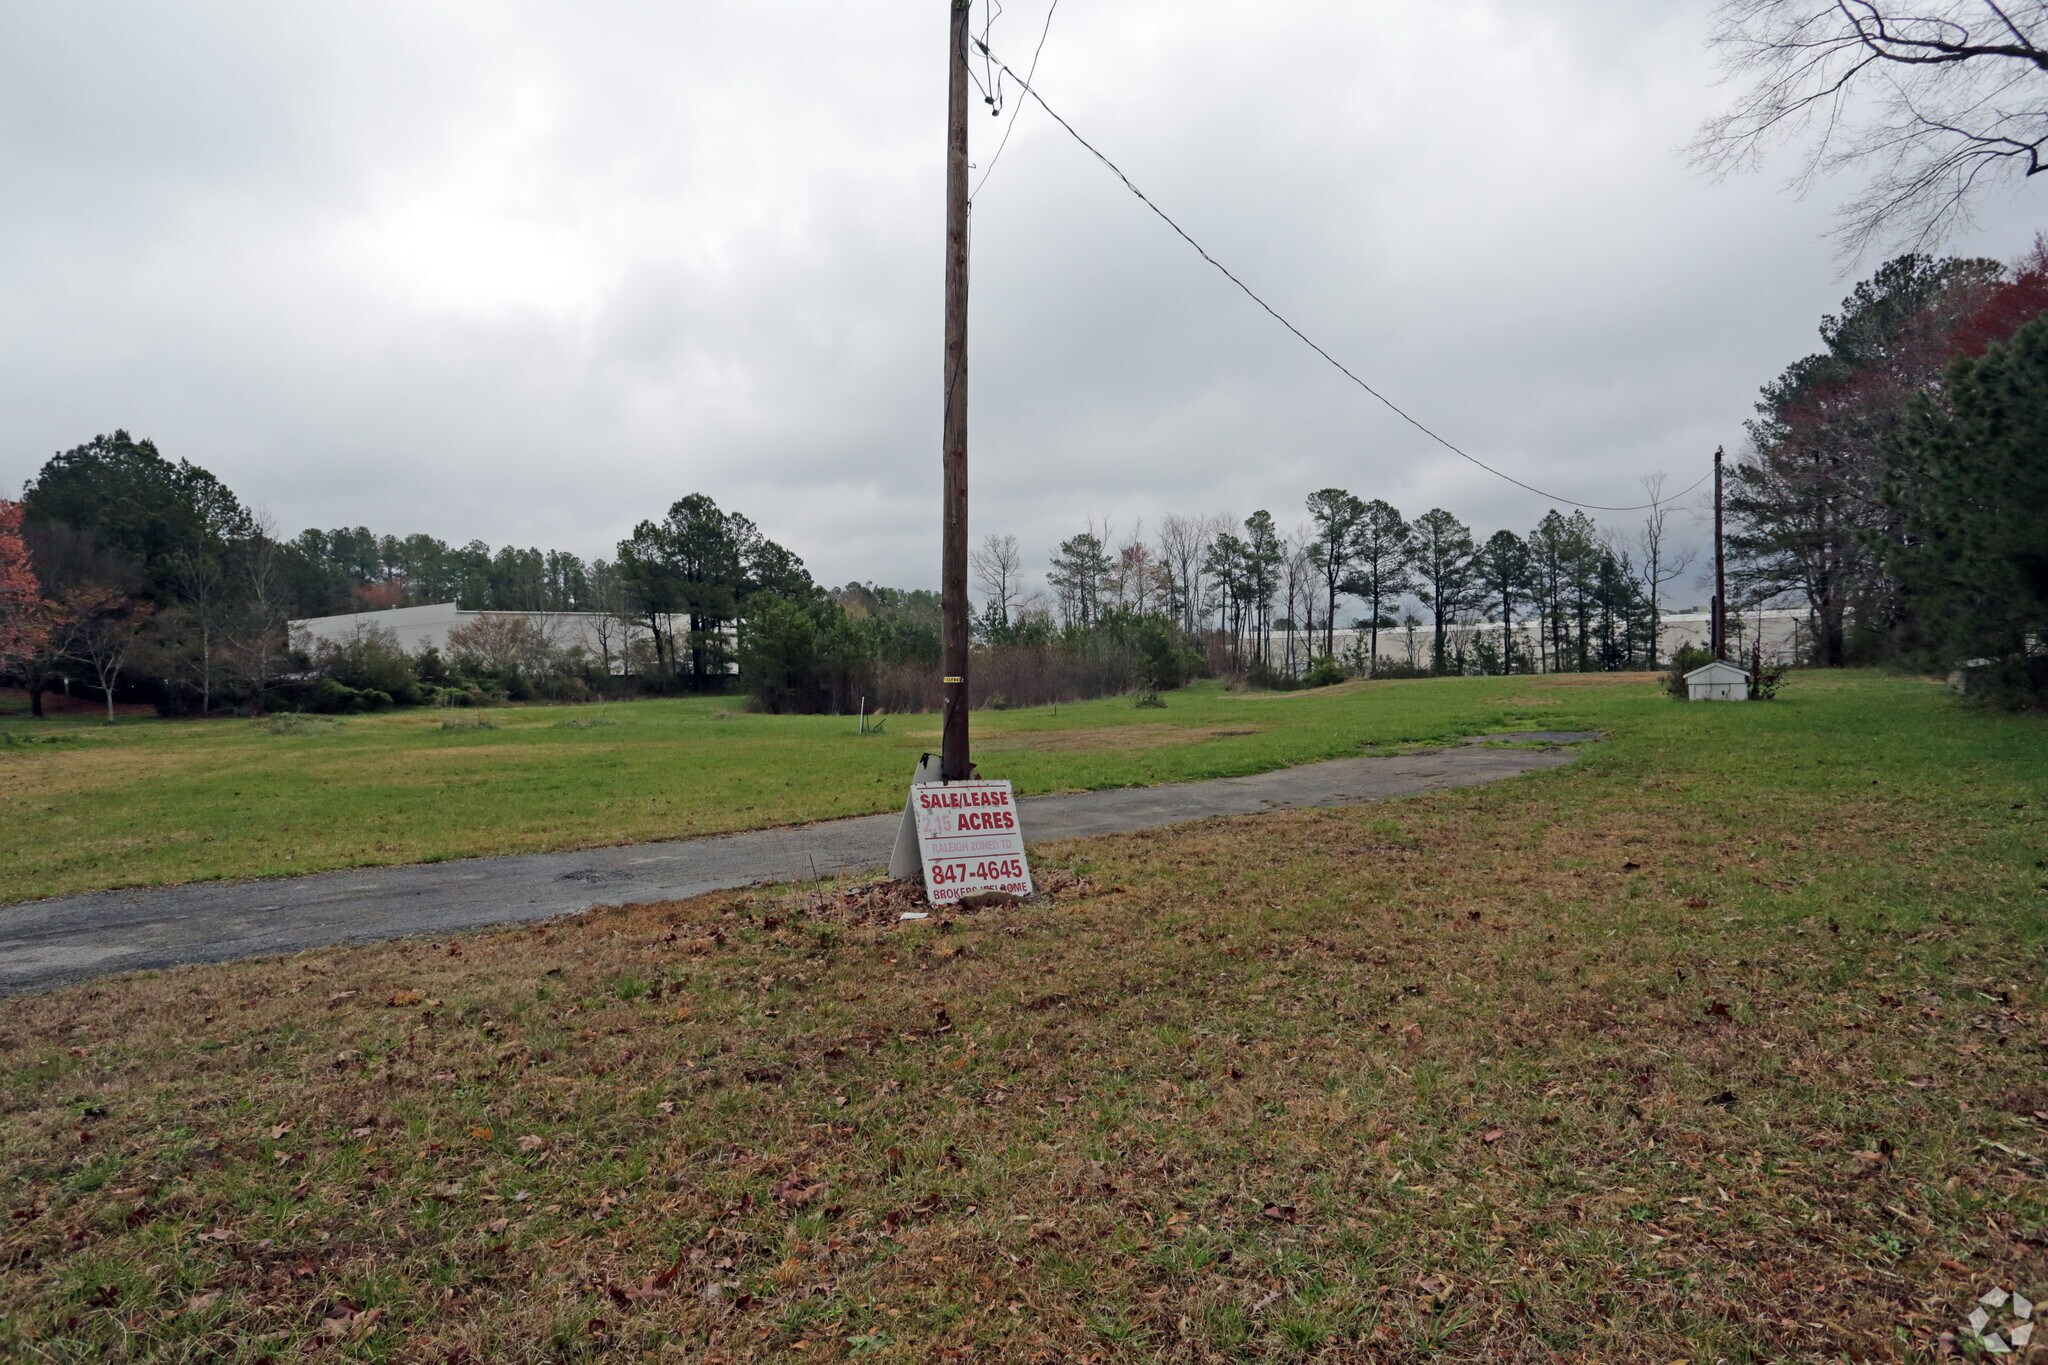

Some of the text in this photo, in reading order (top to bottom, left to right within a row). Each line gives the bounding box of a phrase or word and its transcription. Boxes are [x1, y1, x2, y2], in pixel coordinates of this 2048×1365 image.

[920, 791, 1009, 809] SALE/LEASE
[957, 811, 1014, 831] ACRES
[932, 841, 969, 853] RALEIGH
[971, 839, 999, 851] ZONED
[931, 859, 1023, 885] 847-4645
